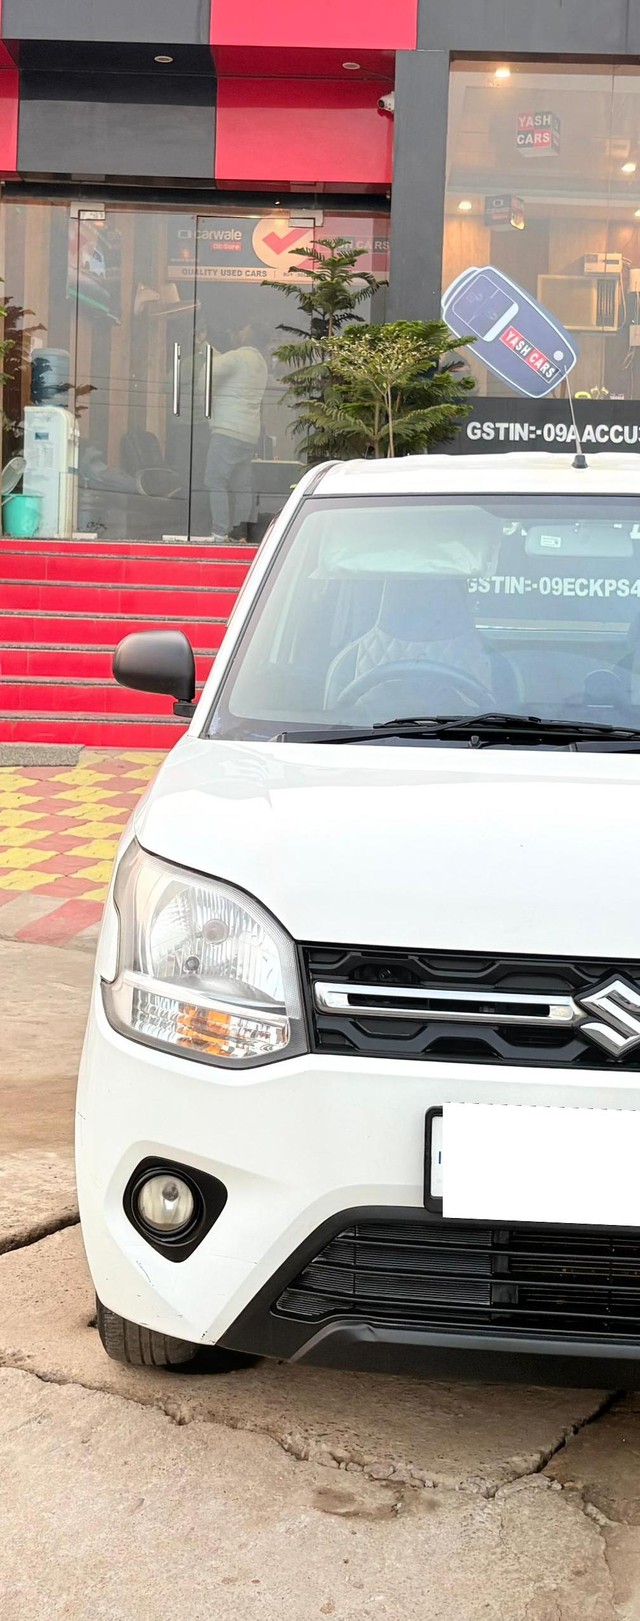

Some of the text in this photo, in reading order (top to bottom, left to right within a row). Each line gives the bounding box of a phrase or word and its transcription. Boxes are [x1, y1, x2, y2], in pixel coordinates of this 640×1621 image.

[518, 114, 551, 128] YASH
[516, 132, 550, 145] CARS
[194, 228, 242, 241] carwale
[356, 240, 390, 250] CARS
[182, 268, 268, 278] QUALITY USED CARS
[505, 330, 555, 379] YASH CARS
